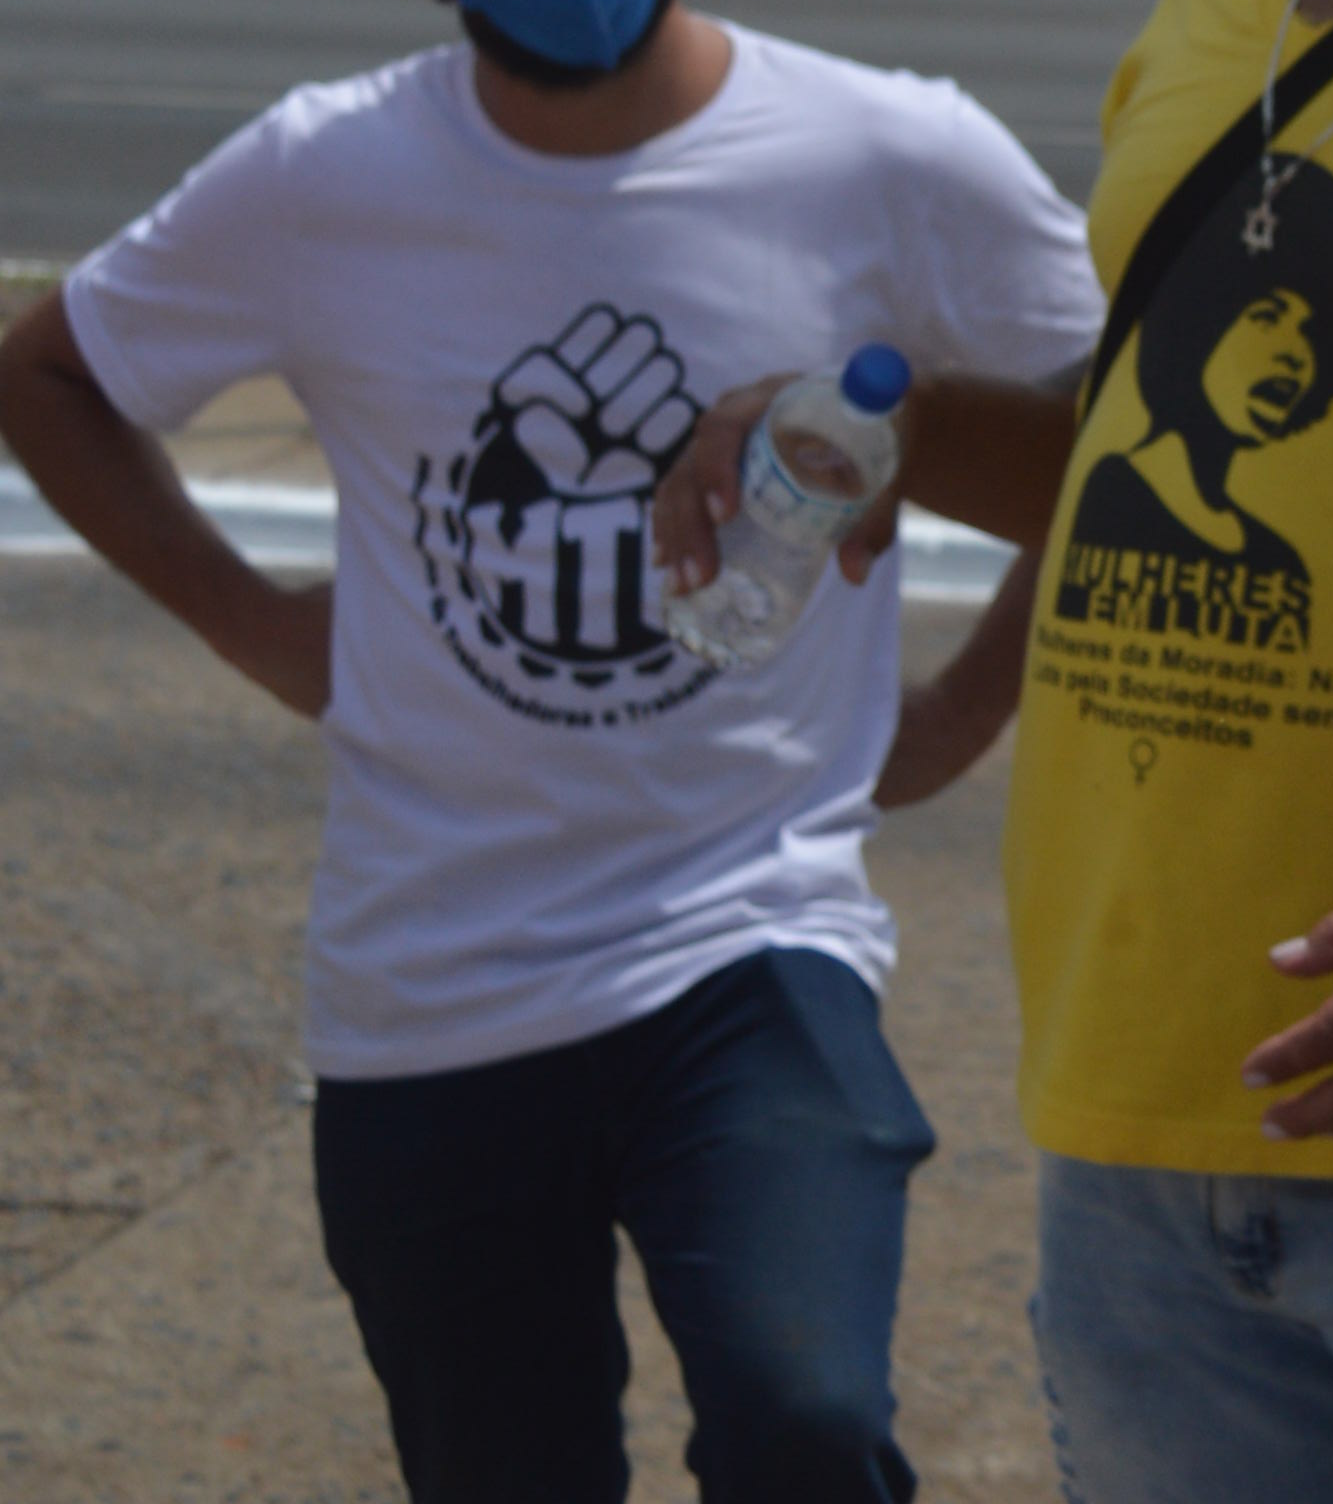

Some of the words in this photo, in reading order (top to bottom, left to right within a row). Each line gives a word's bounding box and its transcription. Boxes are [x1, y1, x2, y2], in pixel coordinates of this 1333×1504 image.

[1065, 542, 1311, 615] MULHERES
[1088, 589, 1148, 632] EM
[1163, 593, 1308, 652] LUTA
[1119, 642, 1150, 667] da
[1117, 671, 1271, 720] Sociedade
